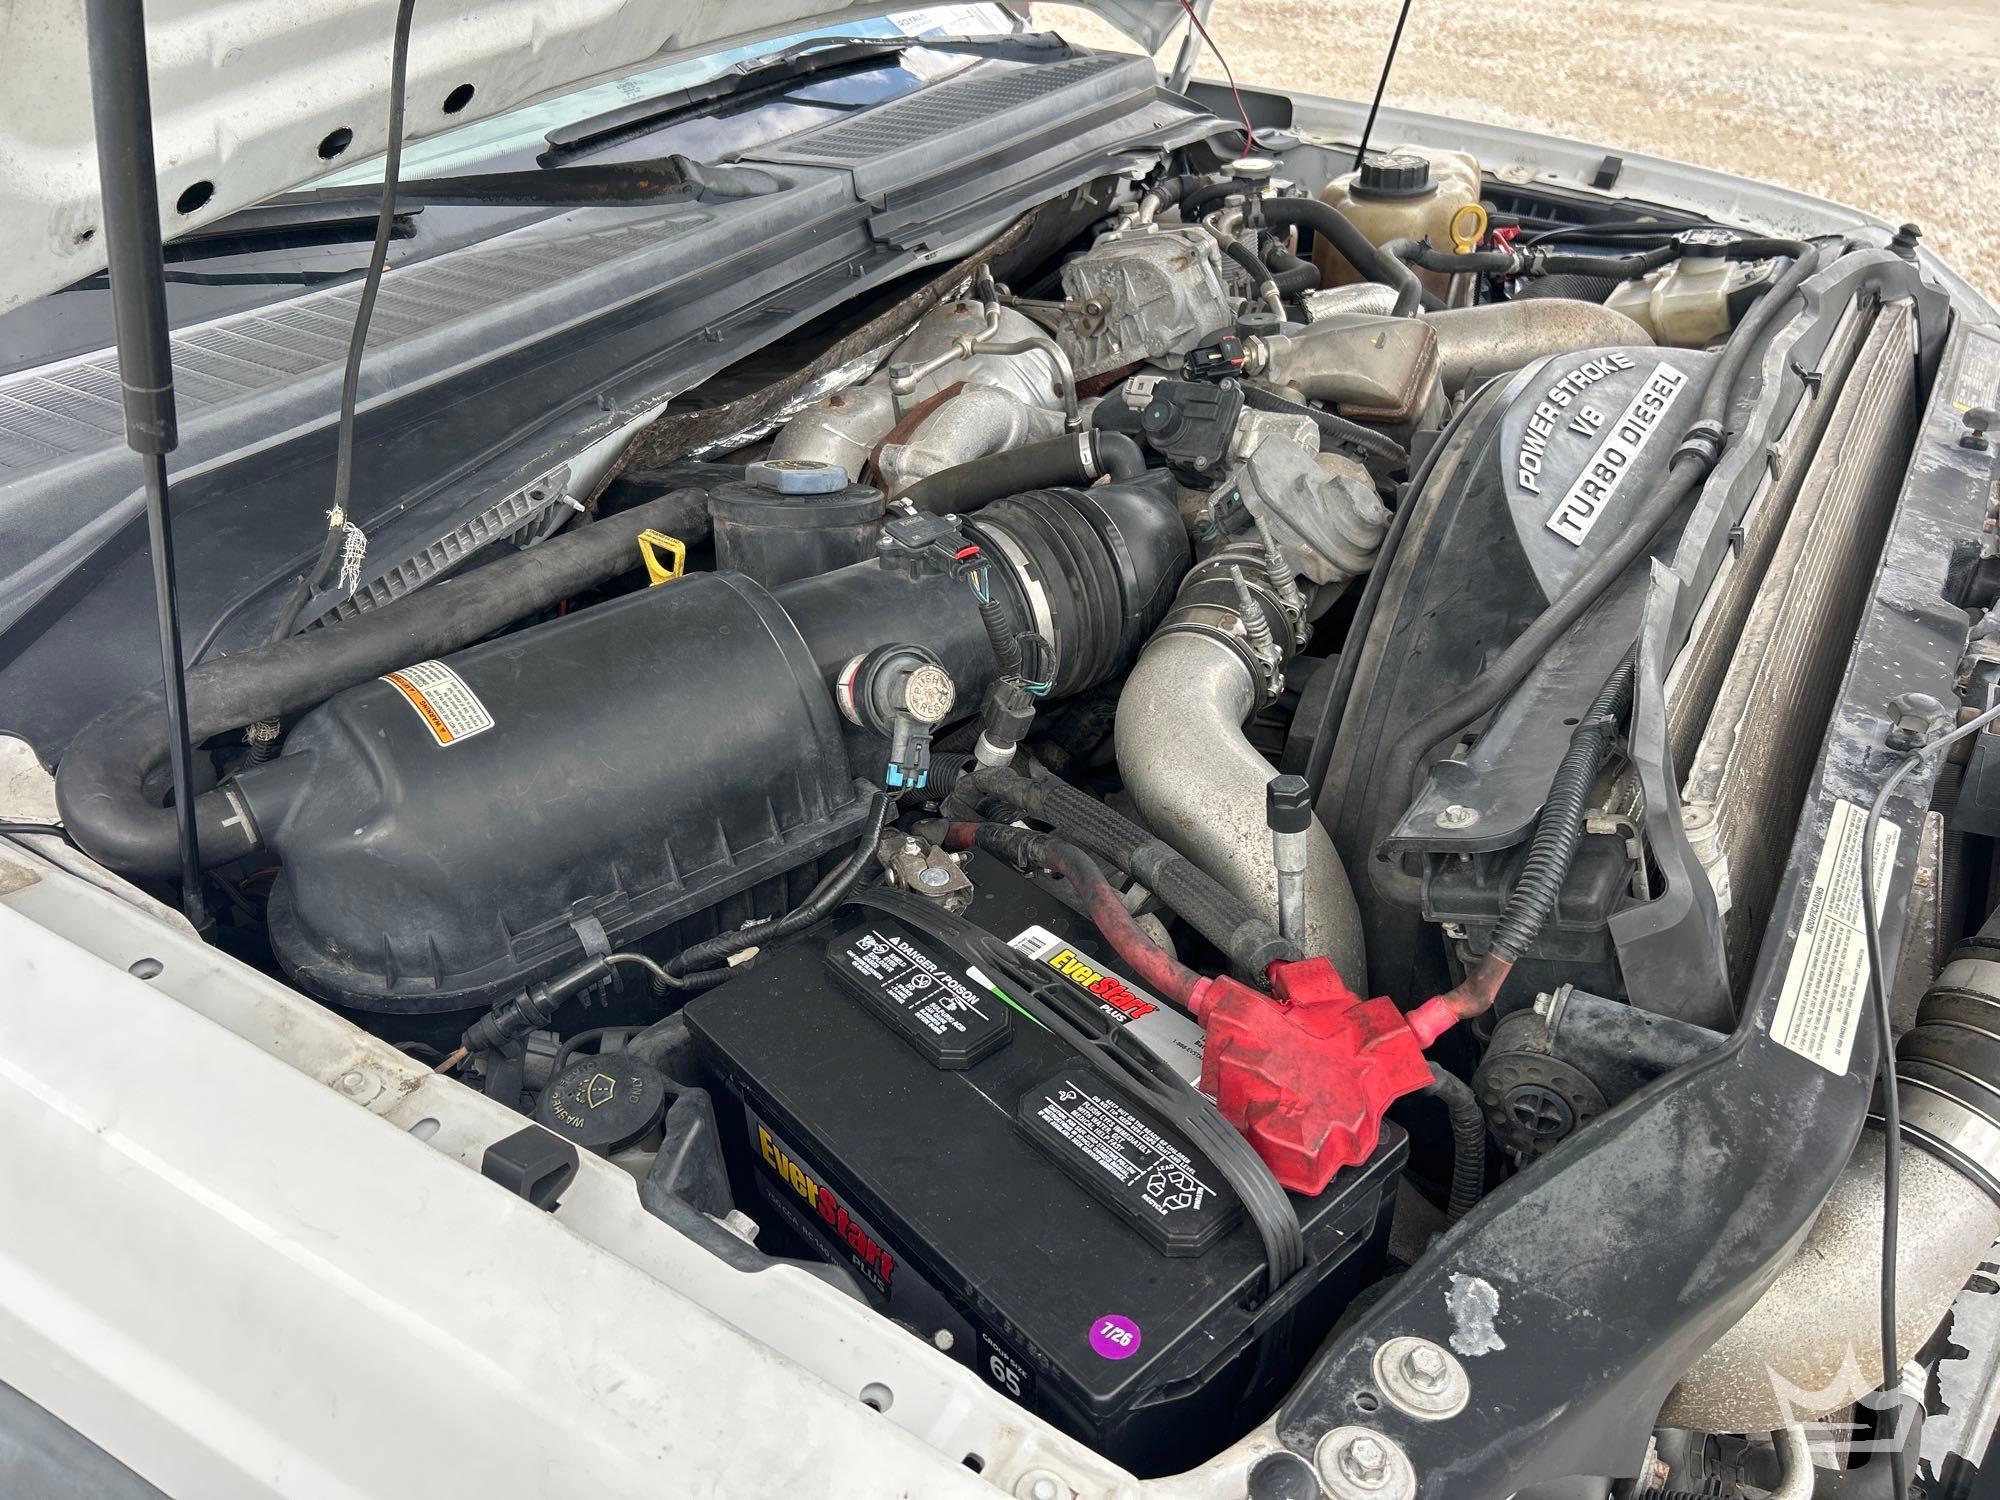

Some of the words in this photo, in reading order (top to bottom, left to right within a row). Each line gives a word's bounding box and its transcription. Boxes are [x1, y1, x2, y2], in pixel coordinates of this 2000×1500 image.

[1518, 401, 1560, 494] POWER
[1548, 352, 1635, 407] STROKE
[1568, 404, 1605, 438] V8
[1556, 447, 1627, 532] TURBO
[1617, 373, 1682, 447] DIESEL
[914, 674, 939, 694] PUSH
[419, 700, 442, 727] WARNING
[1804, 886, 1825, 935] MODIFICATIONS
[898, 942, 937, 972] DANGER
[941, 975, 979, 1005] POISON
[1049, 949, 1158, 1019] EverStart
[930, 1003, 954, 1022] SULFURIC
[952, 1021, 966, 1031] ACID
[1100, 1004, 1128, 1022] PLUS
[629, 1076, 643, 1104] ONLY
[552, 1092, 585, 1129] WASHER
[1042, 1114, 1054, 1122] NOT
[1066, 1119, 1076, 1127] FOR
[1075, 1106, 1093, 1118] WITH
[1112, 1133, 1125, 1144] GET
[1082, 1101, 1102, 1116] FLUSH
[1100, 1115, 1115, 1127] EYES
[1113, 1125, 1151, 1154] IMMEDIATELY
[1071, 1110, 1097, 1130] MEDICAL
[1094, 1128, 1112, 1139] HELP
[1108, 1138, 1124, 1151] FAST
[1100, 1101, 1110, 1109] NOT
[1119, 1116, 1132, 1125] KEEP
[1131, 1124, 1145, 1135] VENT
[1143, 1133, 1157, 1145] CAPS
[1155, 1143, 1172, 1155] TIGHT
[1169, 1154, 1182, 1163] AND
[1180, 1161, 1195, 1174] LEVEL
[1106, 1100, 1118, 1109] KEEP
[1118, 1108, 1129, 1116] OUT
[1134, 1120, 1145, 1129] THE
[1143, 1128, 1160, 1141] REACH
[1166, 1145, 1191, 1163] CHILDREN
[1156, 1164, 1175, 1172] LEAD
[758, 1123, 895, 1285] EverStart
[1141, 1193, 1169, 1216] RECYCLE
[852, 1253, 886, 1294] PLUS
[1100, 1321, 1133, 1346] 7/26
[982, 1333, 1009, 1360] GROUP
[1009, 1358, 1028, 1380] SIZE
[990, 1355, 1021, 1397] 65
